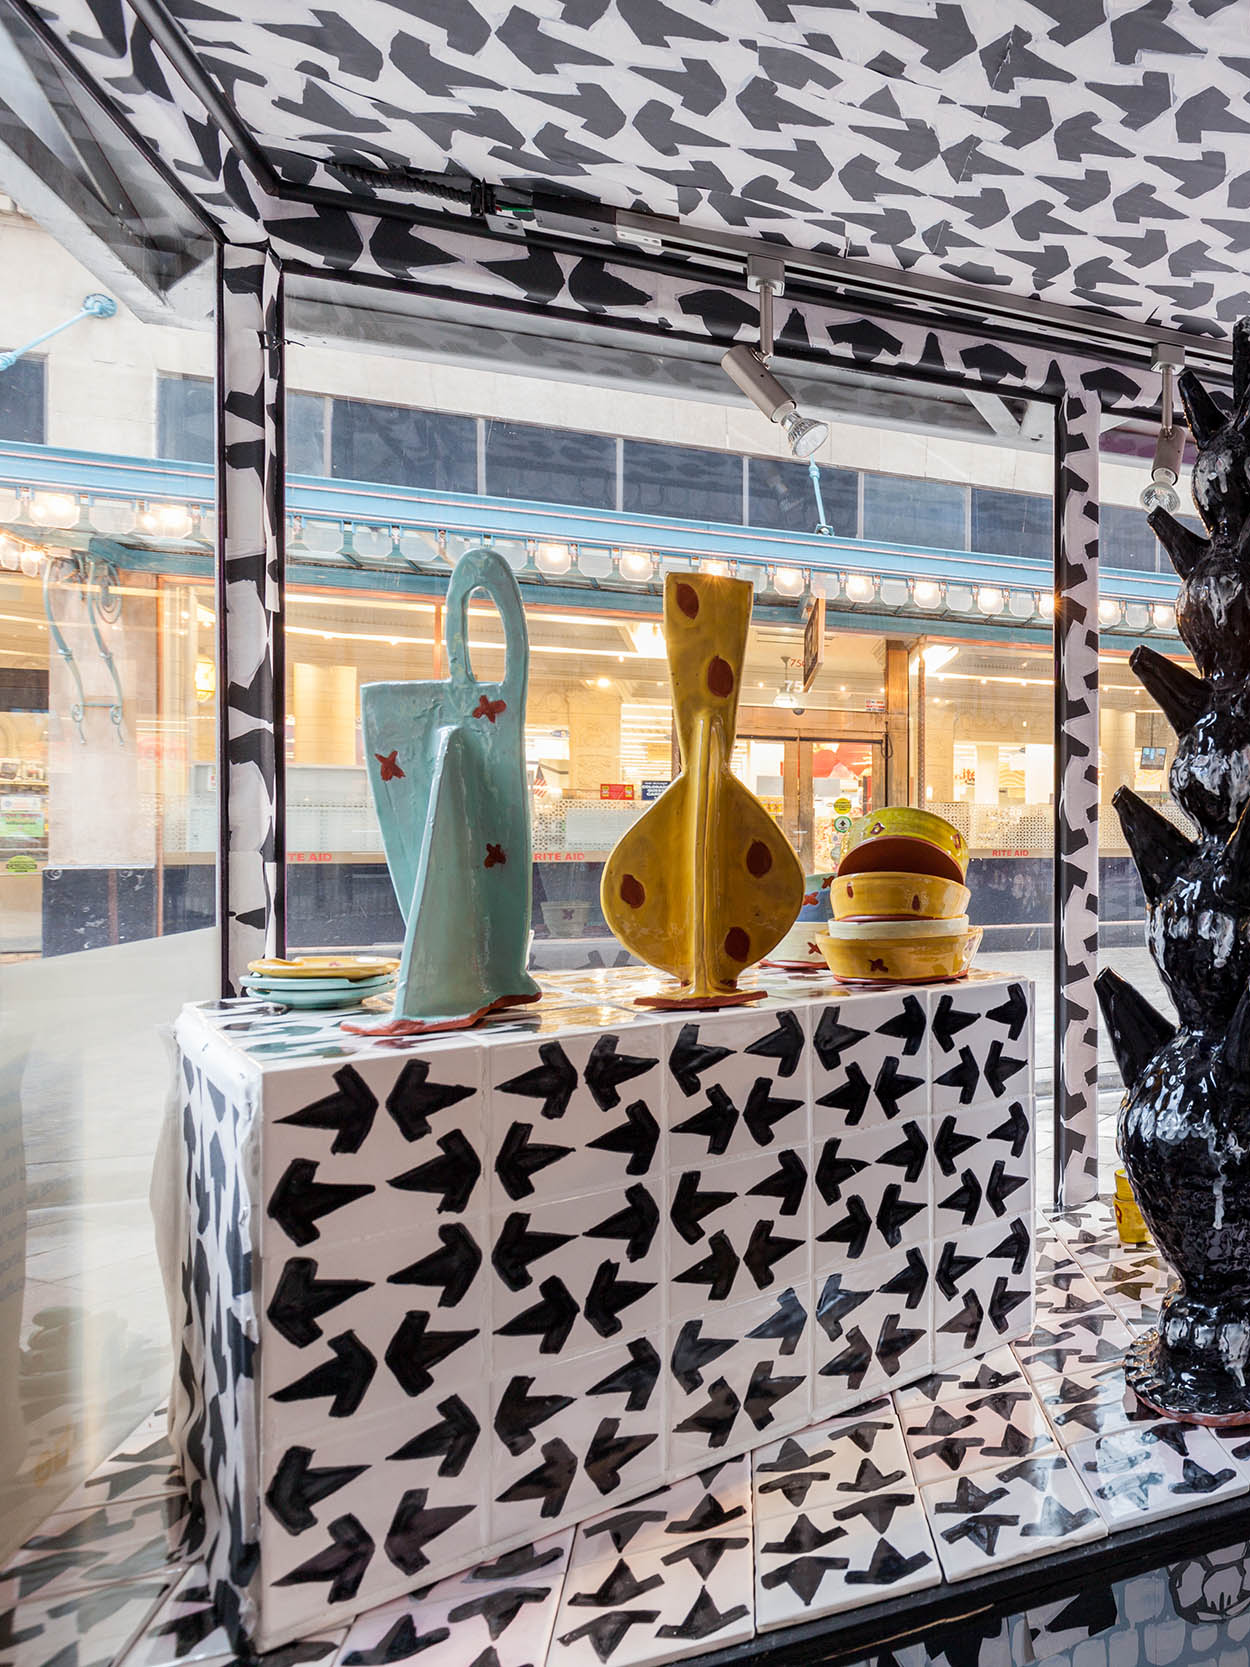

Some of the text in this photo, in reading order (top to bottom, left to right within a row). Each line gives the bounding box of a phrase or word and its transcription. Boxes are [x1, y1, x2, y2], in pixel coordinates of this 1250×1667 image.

[287, 852, 332, 862] TE AID
[533, 852, 585, 861] RITE AID
[992, 849, 1029, 857] RITE AID
